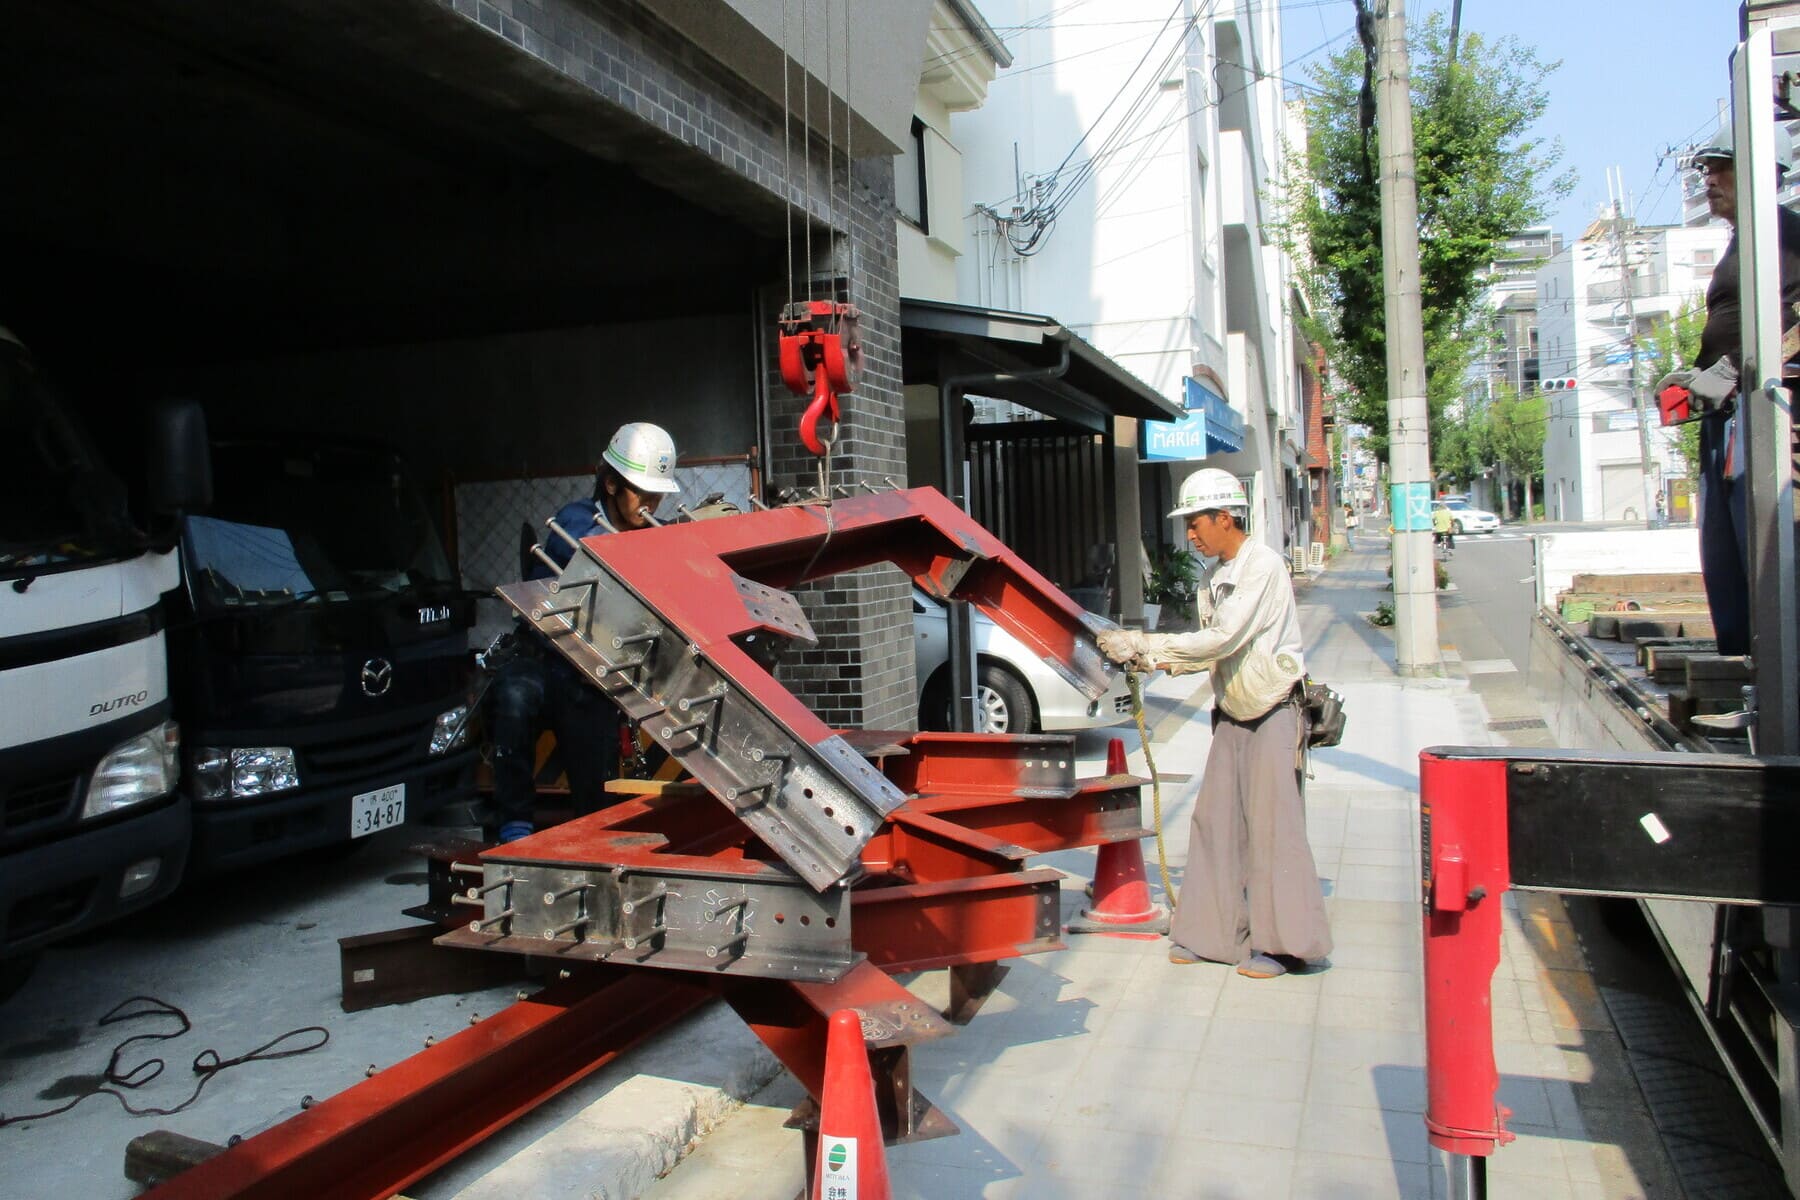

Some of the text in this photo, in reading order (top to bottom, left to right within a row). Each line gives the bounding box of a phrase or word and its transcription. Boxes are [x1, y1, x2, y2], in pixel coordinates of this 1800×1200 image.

[1152, 431, 1200, 449] MARIA
[89, 690, 148, 717] DUTRO
[381, 789, 395, 802] 400
[364, 801, 402, 832] 34-87
